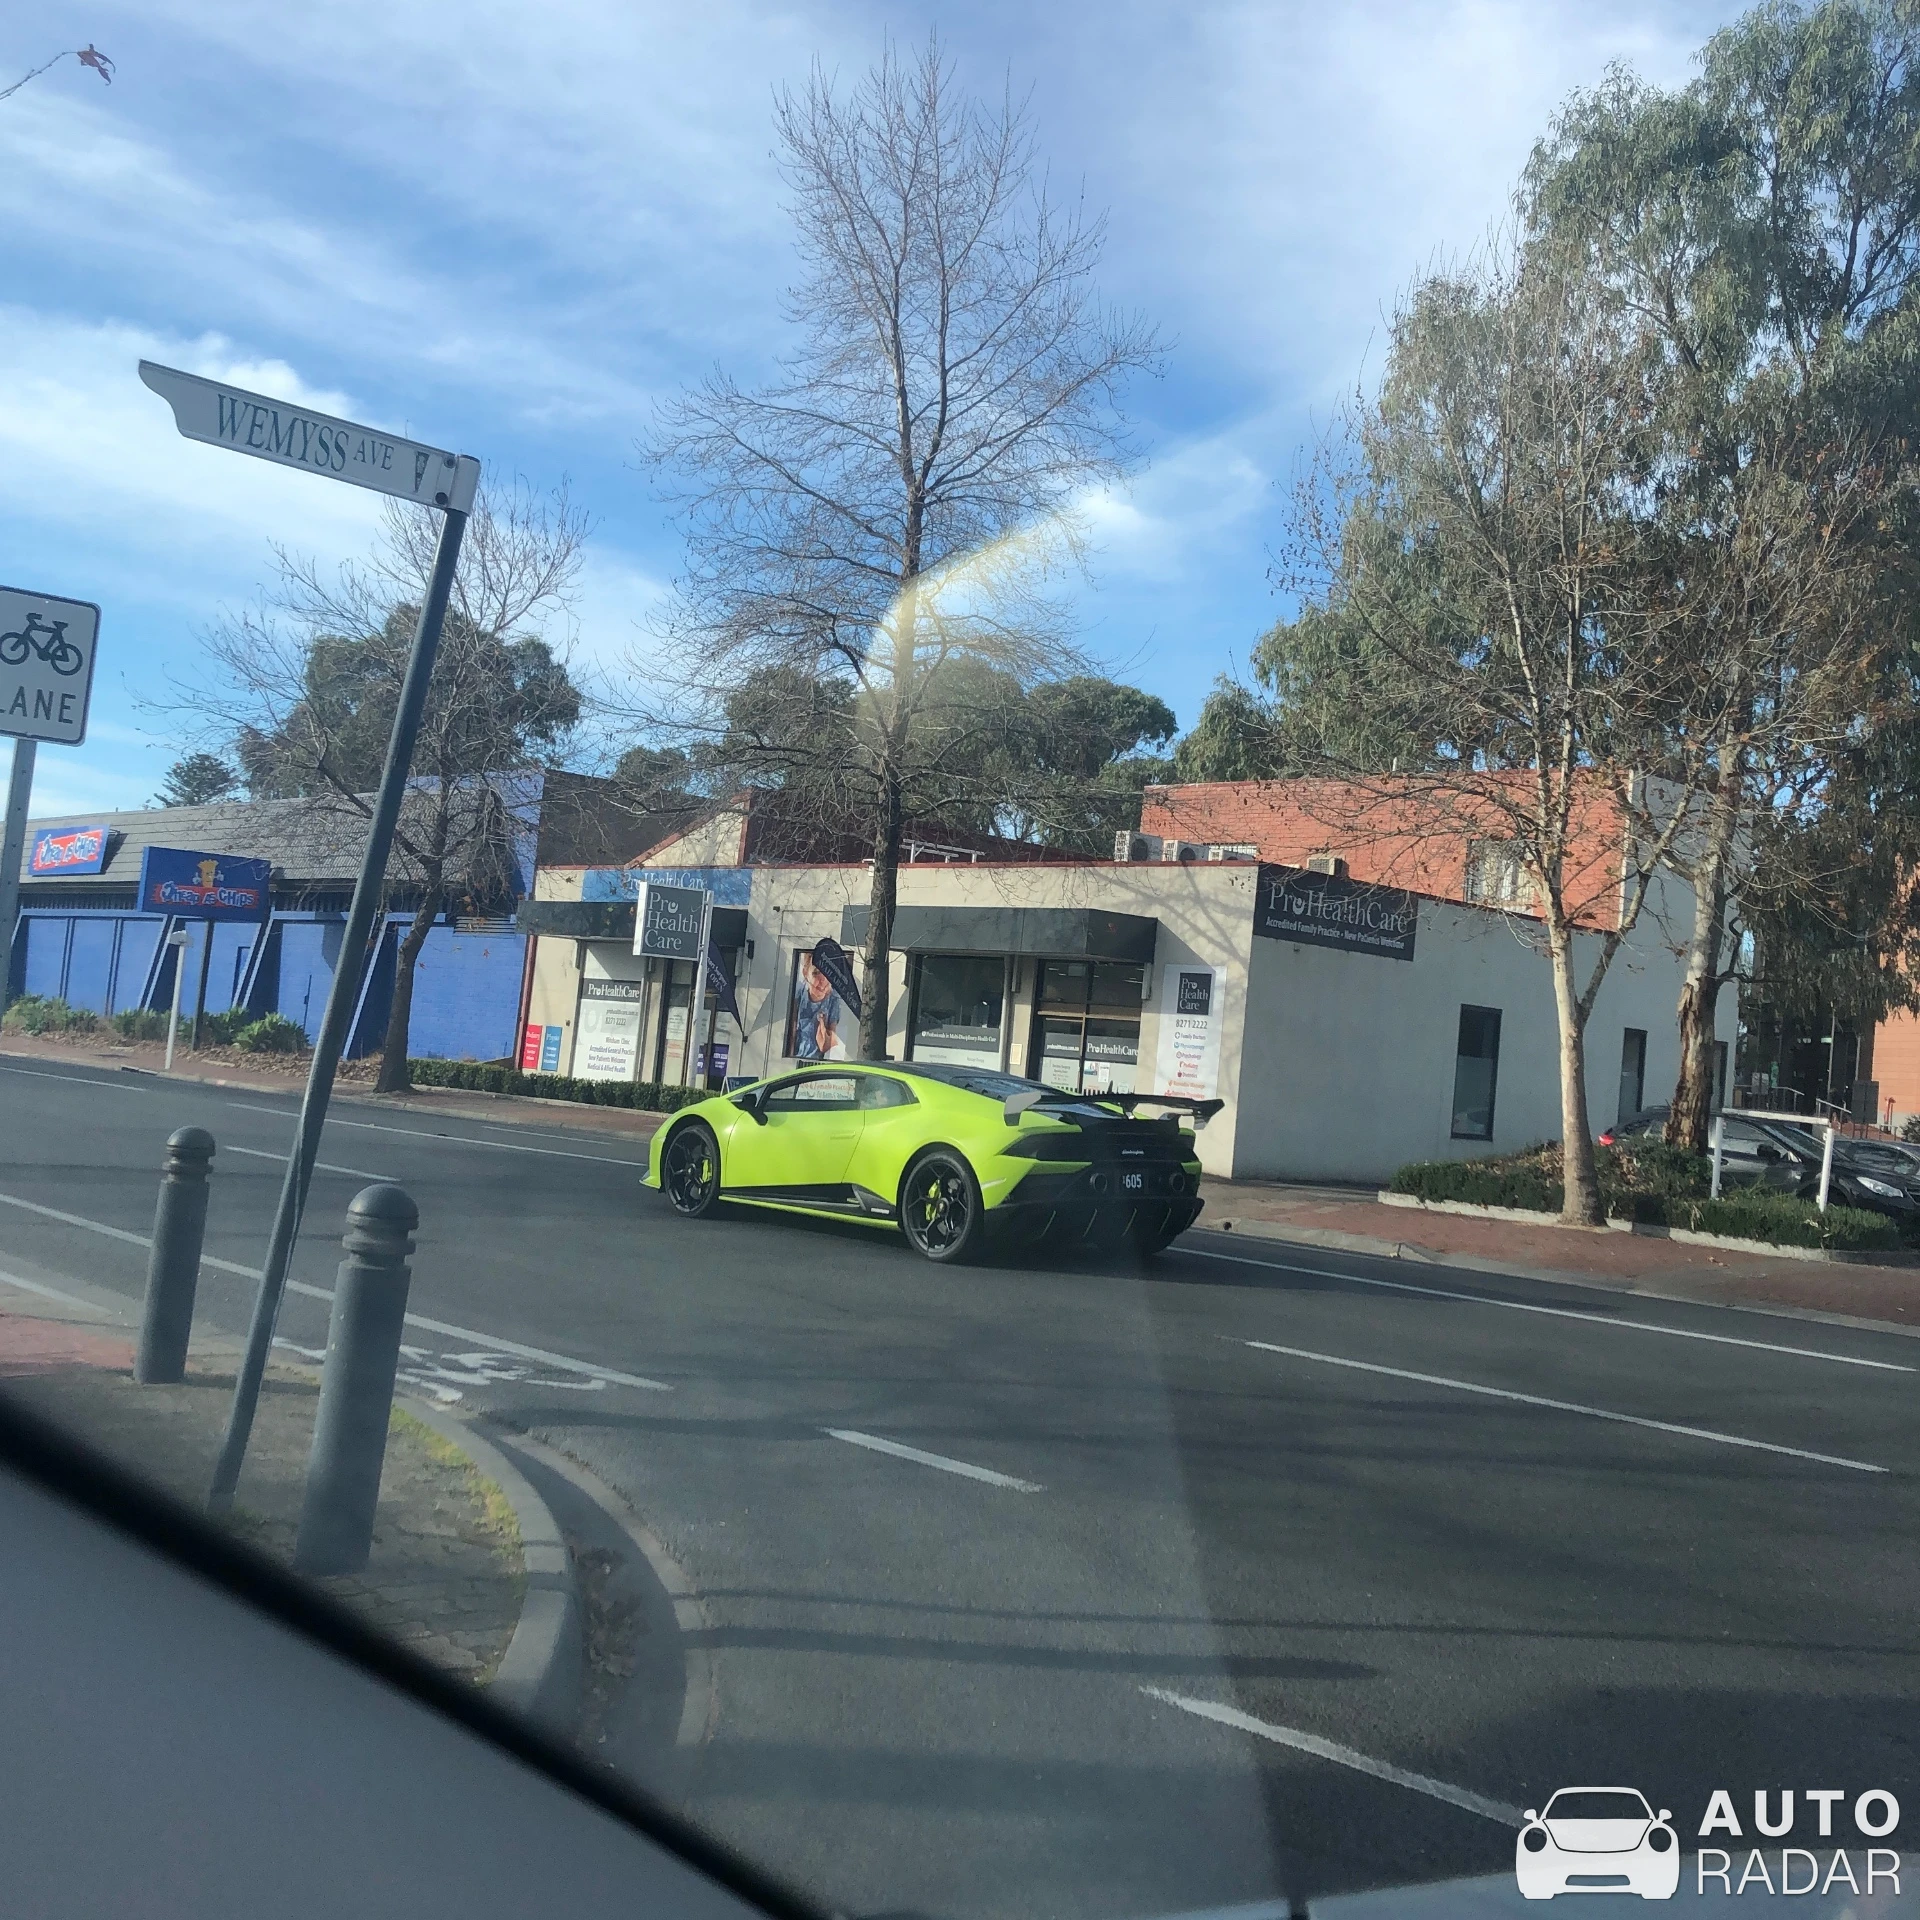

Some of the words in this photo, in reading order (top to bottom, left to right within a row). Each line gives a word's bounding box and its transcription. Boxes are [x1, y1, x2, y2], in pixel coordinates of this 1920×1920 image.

[216, 393, 350, 472] WEMYSS
[353, 439, 395, 471] AVE
[0, 686, 76, 724] ANE
[648, 892, 679, 914] Pro
[646, 910, 698, 934] Health
[645, 929, 682, 950] Care
[1266, 916, 1297, 930] Accredited
[1298, 922, 1317, 936] Family
[1318, 925, 1340, 938] Practice
[1344, 930, 1356, 940] New
[1357, 932, 1380, 945] Patients
[1380, 936, 1405, 949] Welcome
[588, 983, 640, 998] ProHealthCare
[1181, 978, 1198, 989] Pro
[1180, 988, 1208, 1000] Health
[1180, 999, 1200, 1010] Care
[1176, 1019, 1190, 1028] 8271
[1192, 1020, 1208, 1029] 2222
[1125, 1174, 1142, 1189] 605
